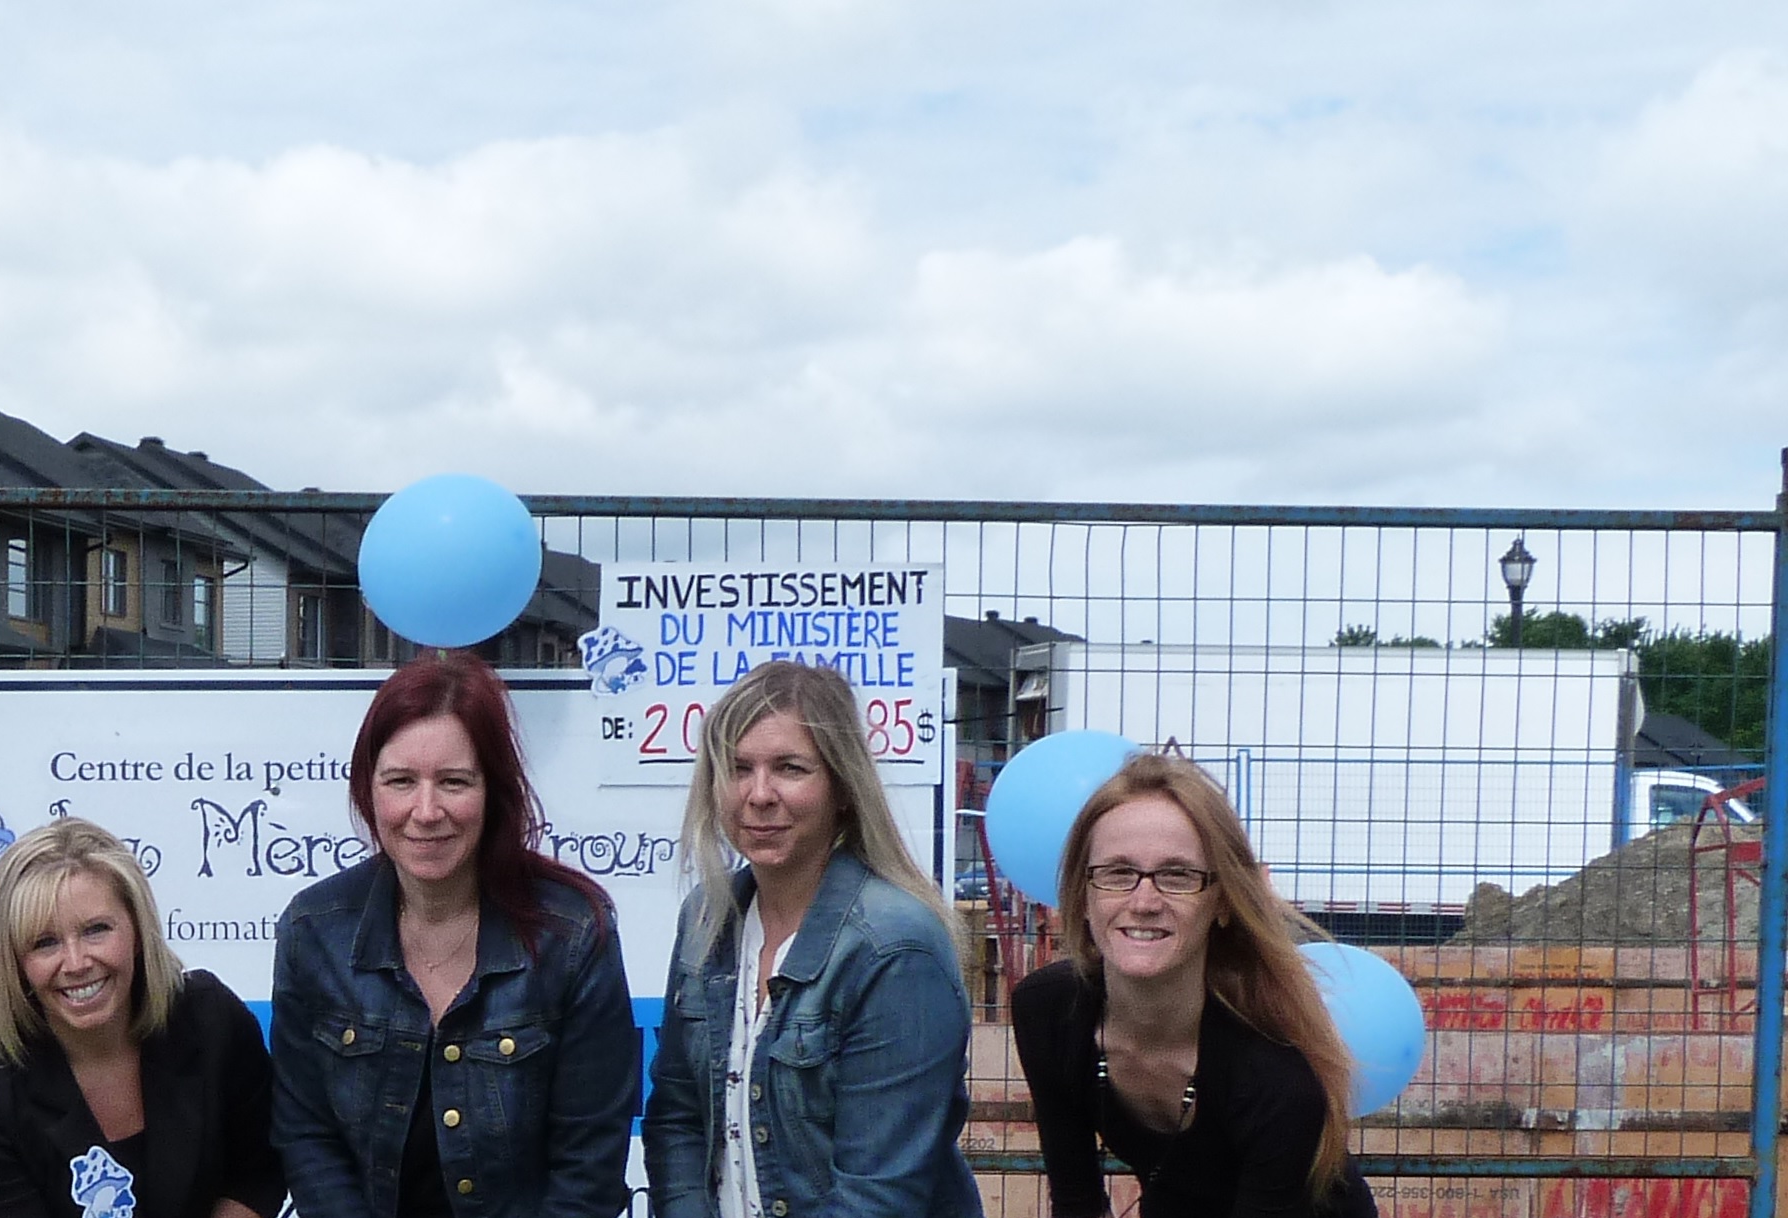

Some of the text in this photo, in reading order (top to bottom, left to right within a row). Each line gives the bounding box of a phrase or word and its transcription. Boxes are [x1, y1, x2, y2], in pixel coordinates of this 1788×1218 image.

[616, 570, 929, 609] INVESTISSEMENT
[661, 606, 899, 648] DU MINISTÈRE
[655, 650, 698, 687] DE
[713, 651, 751, 686] LA
[602, 716, 633, 740] DE:
[50, 752, 164, 782] Centre
[173, 752, 215, 782] de
[224, 752, 254, 782] la
